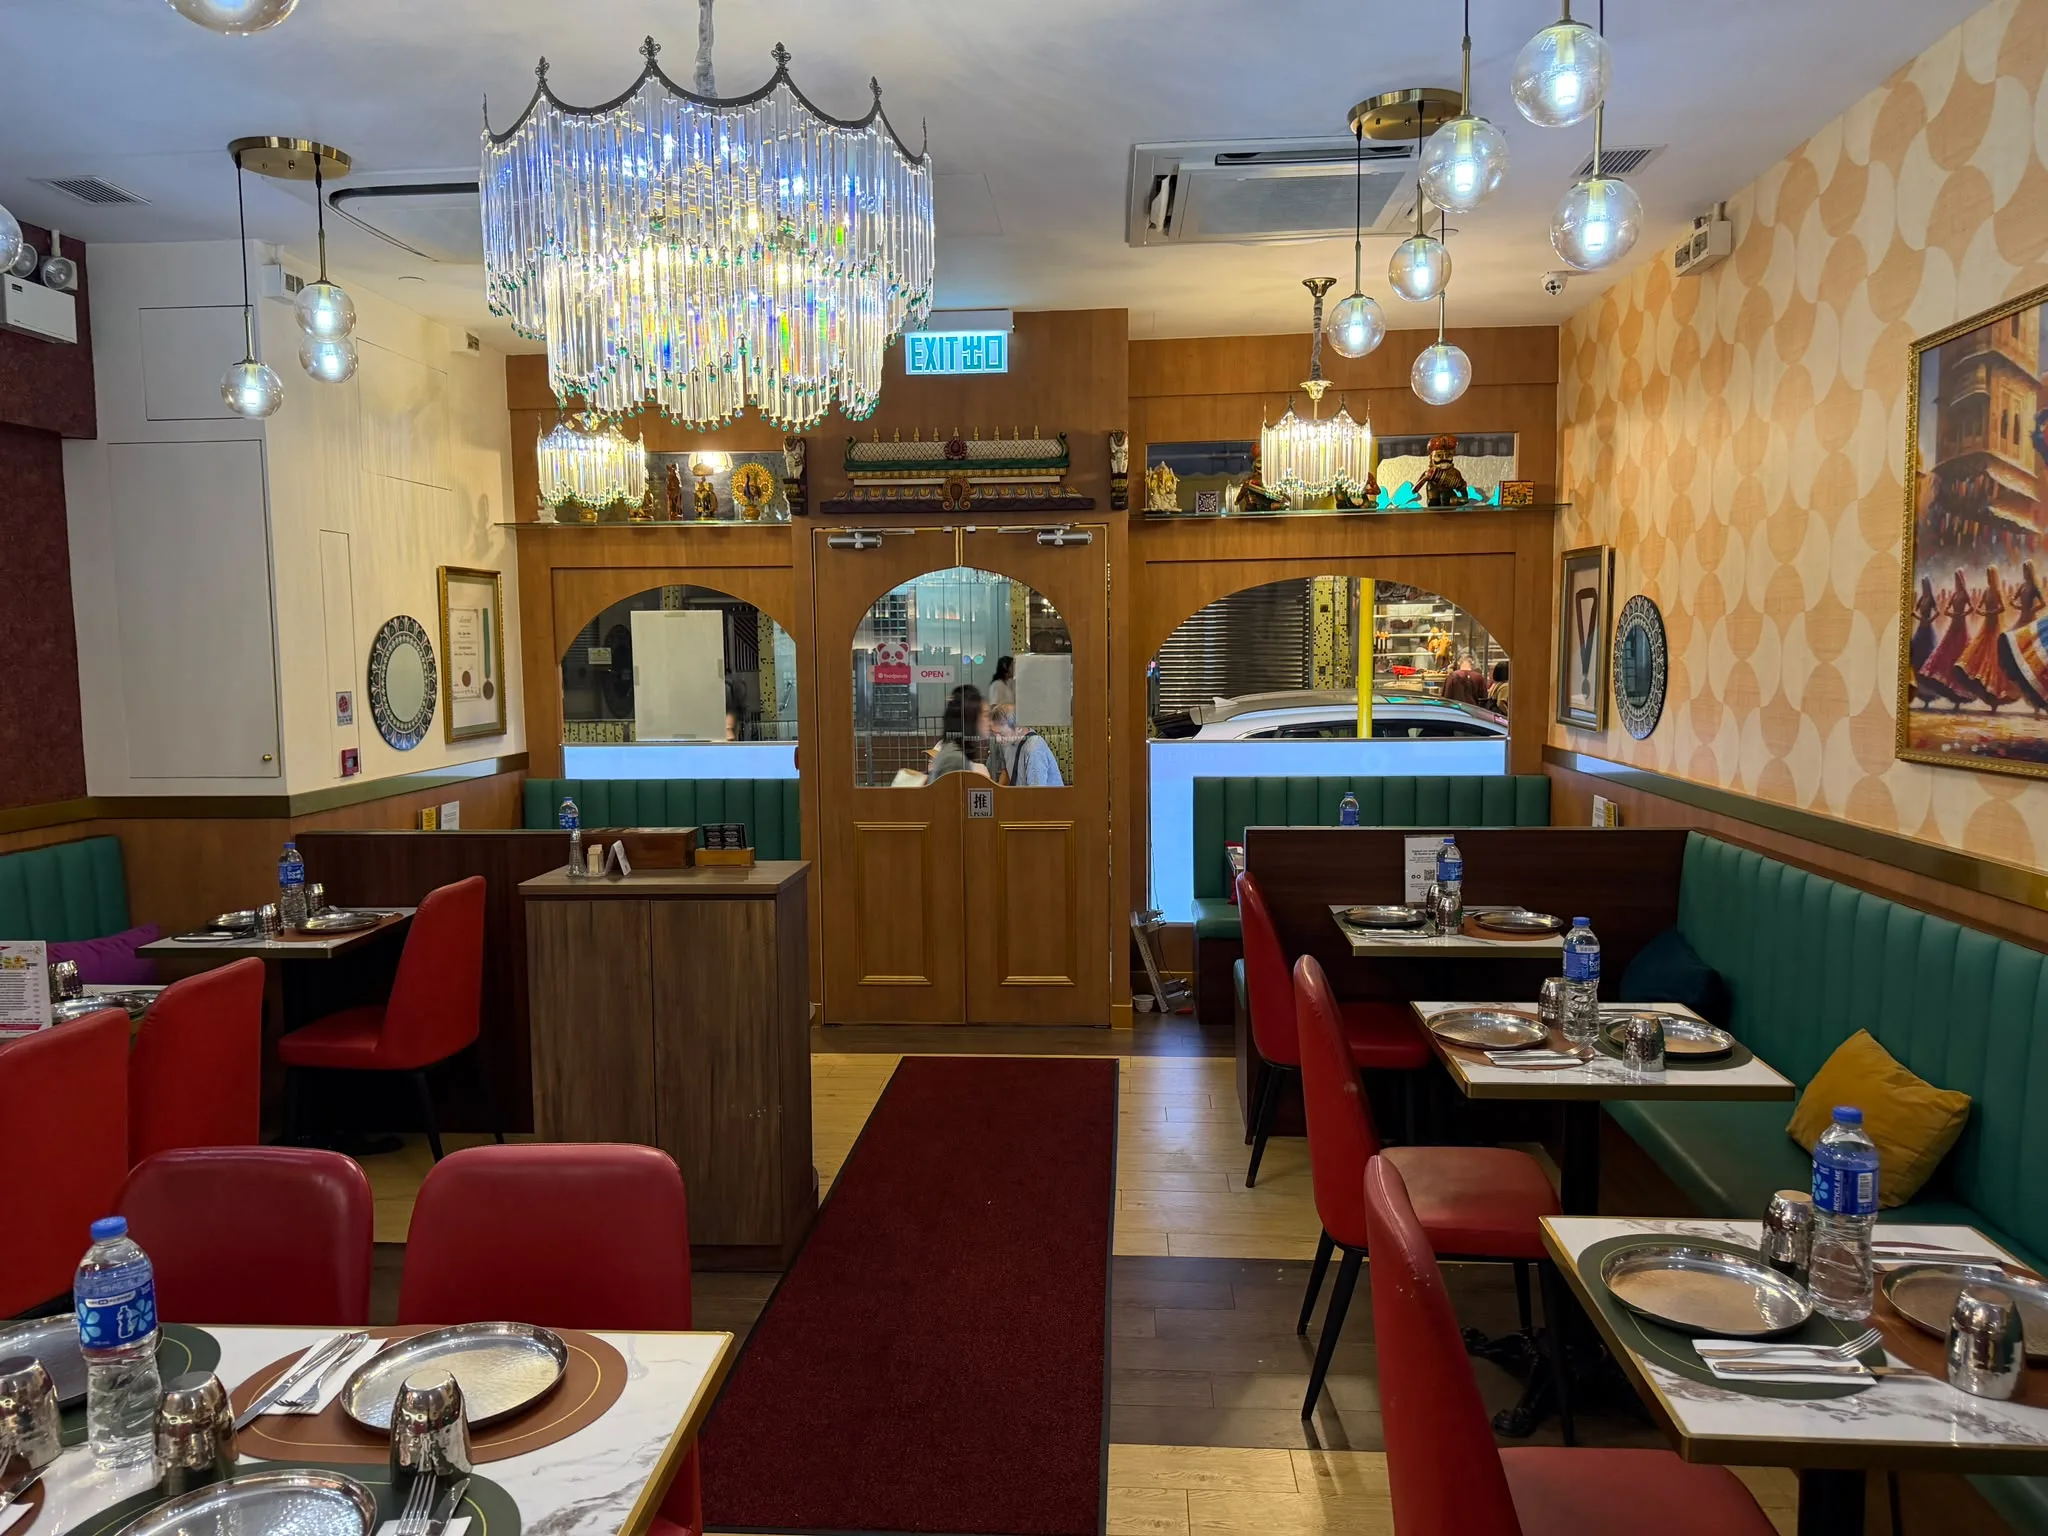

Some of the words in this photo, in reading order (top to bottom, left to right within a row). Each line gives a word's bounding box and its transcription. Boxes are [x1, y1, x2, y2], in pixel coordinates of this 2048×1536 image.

[910, 336, 958, 371] EXIT
[962, 335, 1003, 370] 出口
[920, 670, 944, 678] OPEN
[974, 793, 988, 809] 推
